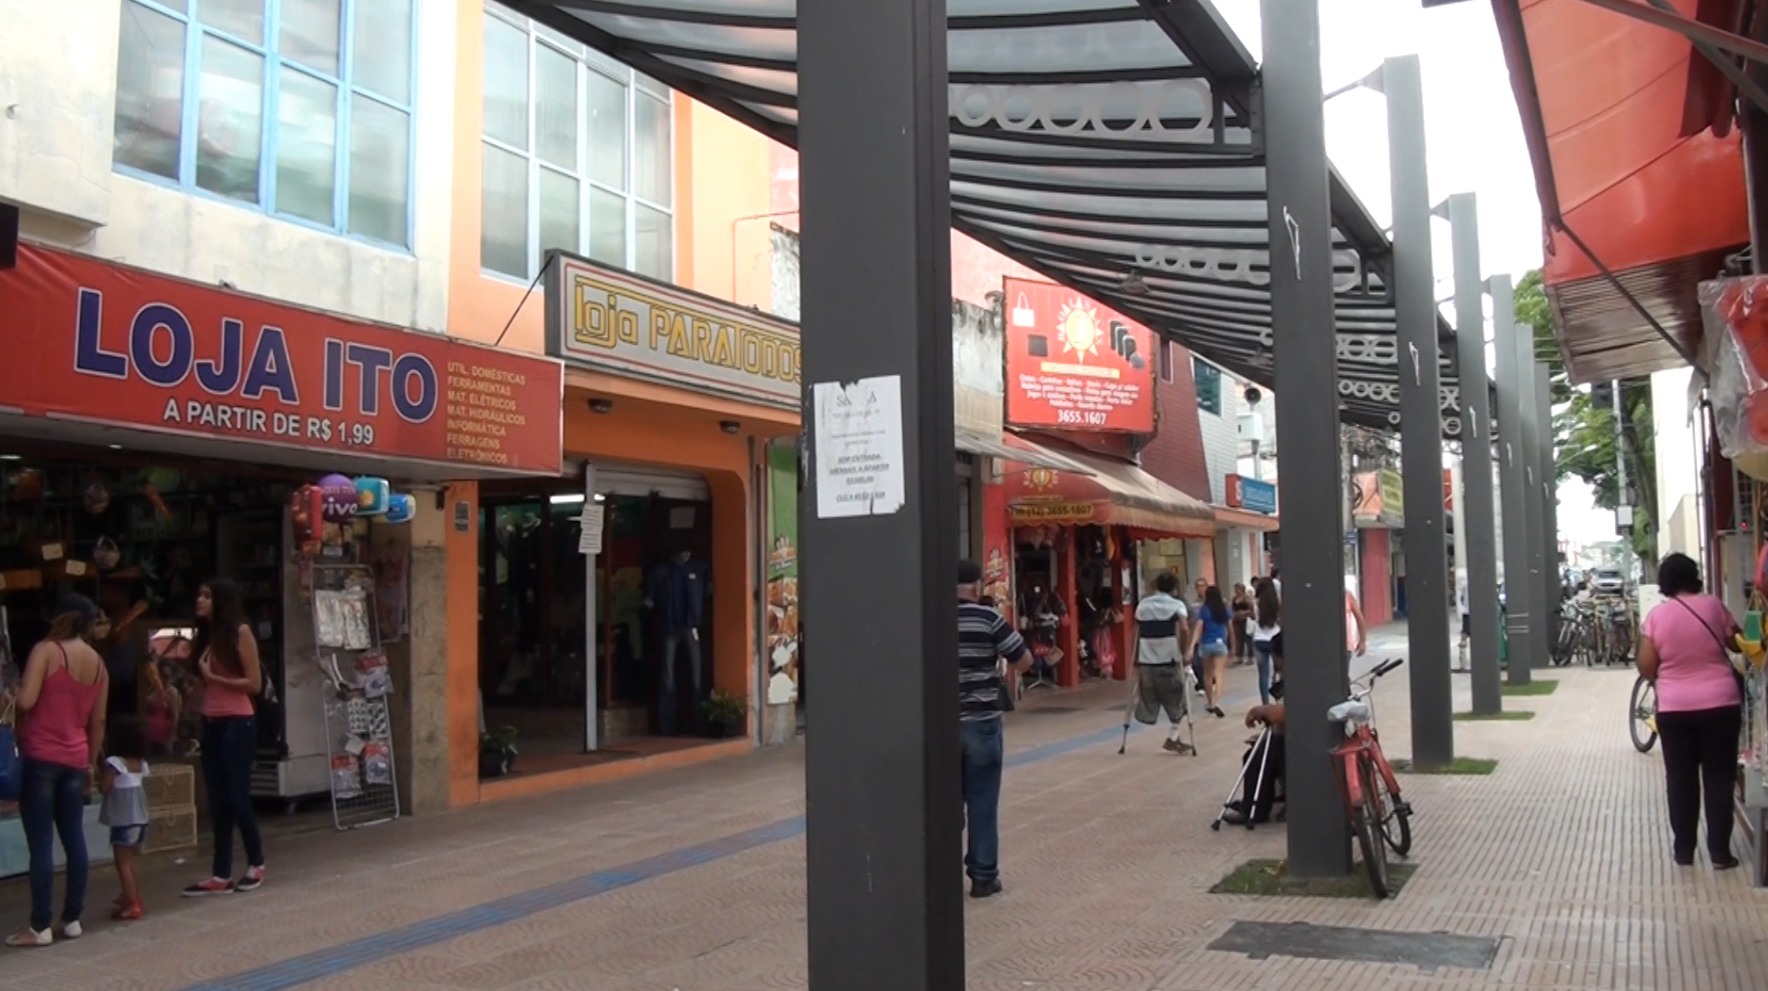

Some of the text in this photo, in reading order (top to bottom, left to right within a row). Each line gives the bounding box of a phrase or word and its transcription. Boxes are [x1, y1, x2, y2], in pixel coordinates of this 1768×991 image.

[74, 286, 438, 423] LOJA ITO
[472, 365, 526, 386] DOMÉSTICAS
[447, 376, 512, 397] FERRAMENTAS
[469, 393, 516, 411] ELÉTRICOS
[163, 398, 374, 446] A PARTIR DE R$ 1,99
[469, 407, 526, 425] HIDRÁULICOS
[1058, 409, 1107, 425] 3655.1607
[447, 419, 507, 437] INFORMÁTICA
[447, 432, 500, 449] FERRAGENS
[447, 447, 508, 464] ELETRÔNICOS
